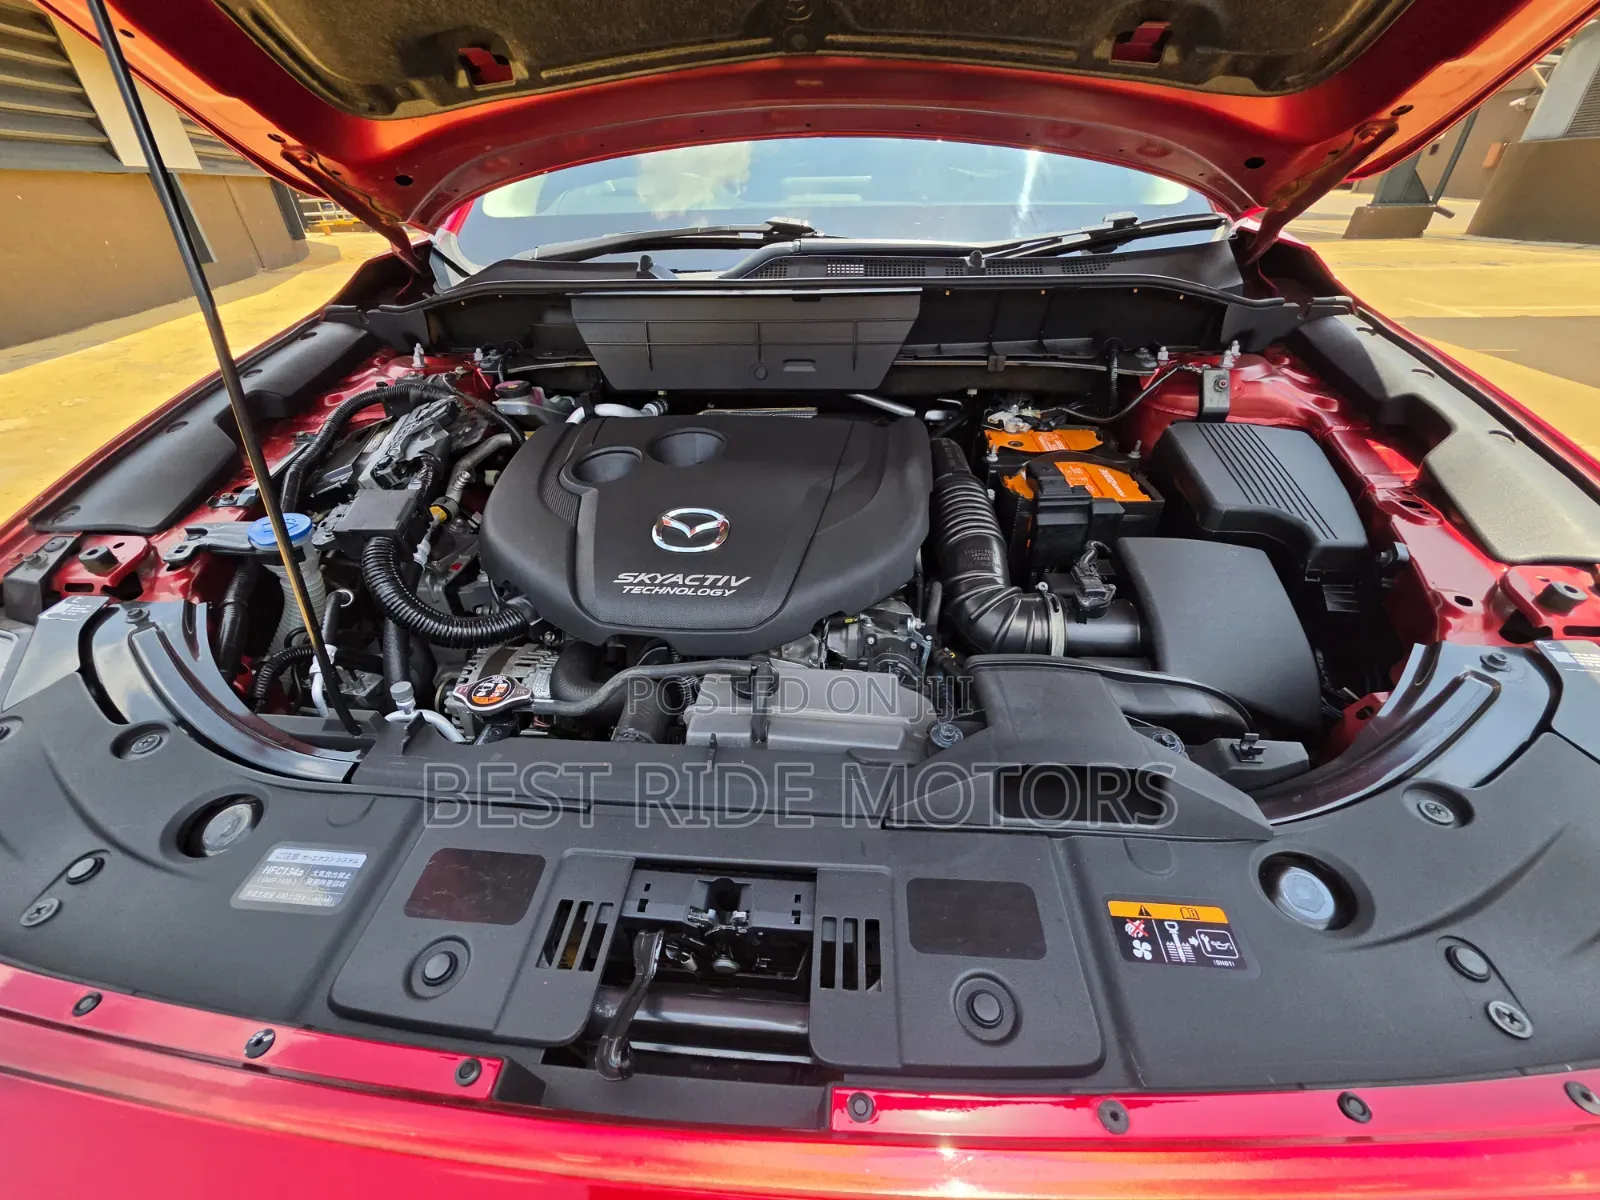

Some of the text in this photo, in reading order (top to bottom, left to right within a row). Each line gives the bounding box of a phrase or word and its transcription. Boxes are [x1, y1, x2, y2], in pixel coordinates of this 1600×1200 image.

[613, 572, 751, 587] SKYACTIV
[622, 585, 737, 597] TECHNOLOGY
[262, 865, 305, 877] HFC134a
